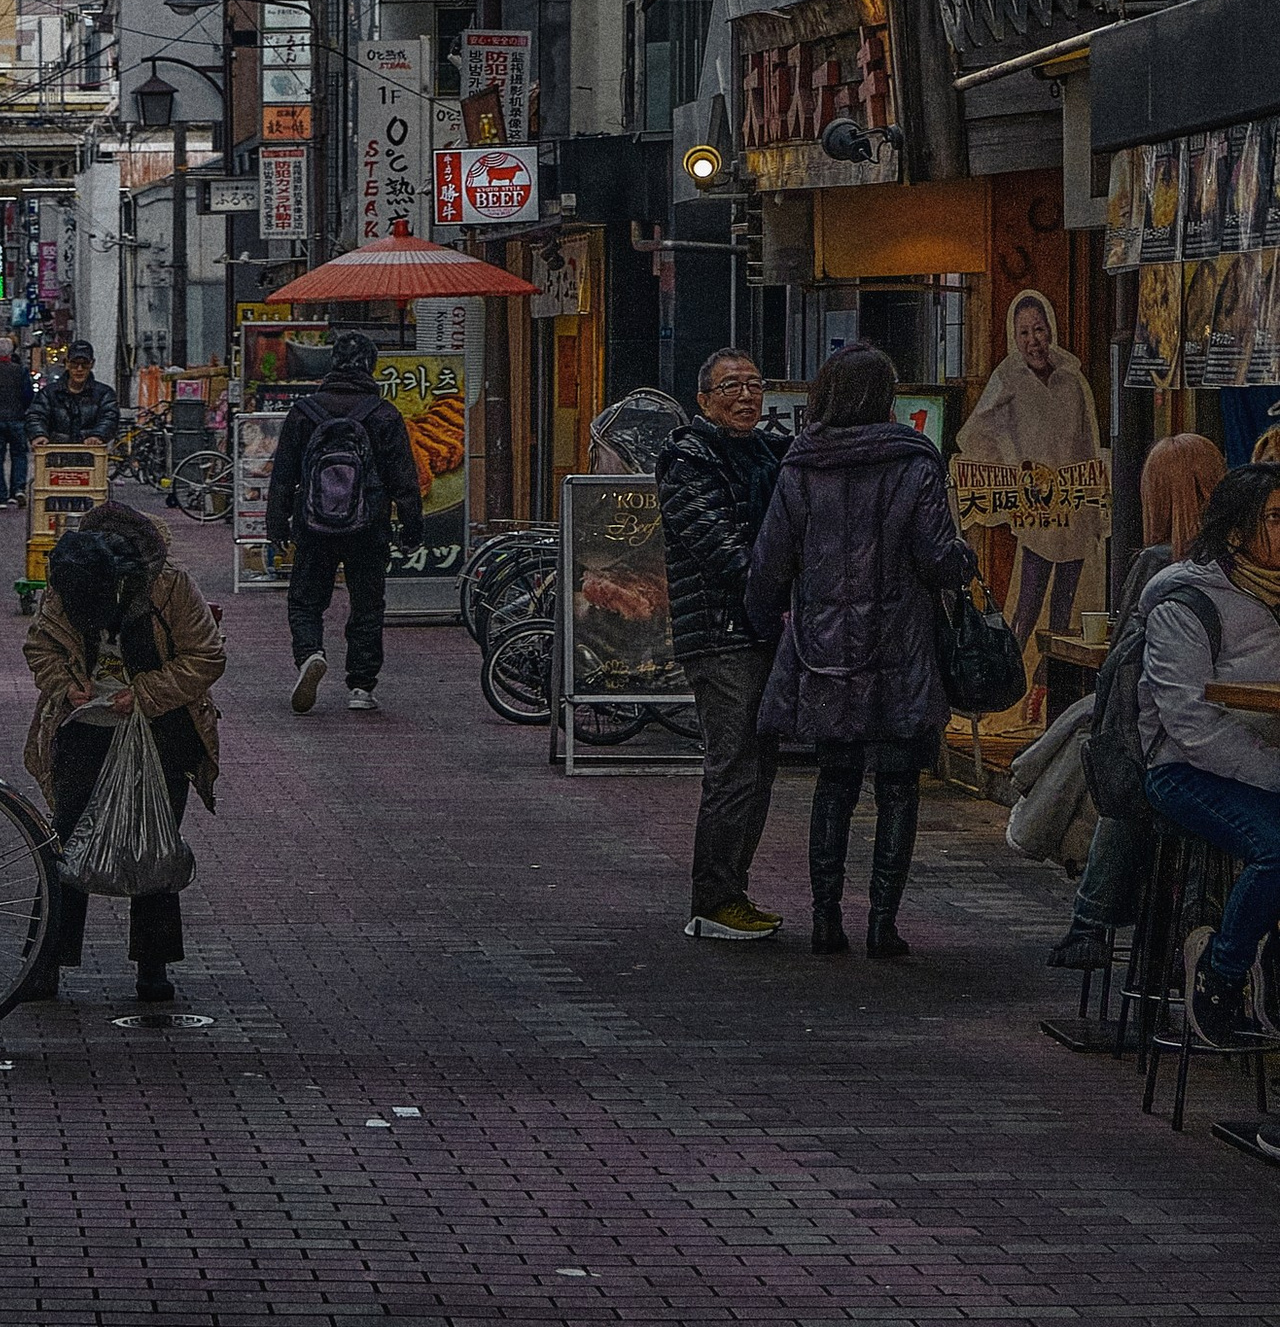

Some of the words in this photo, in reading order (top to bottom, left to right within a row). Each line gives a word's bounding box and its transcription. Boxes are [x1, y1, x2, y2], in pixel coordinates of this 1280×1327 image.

[378, 86, 402, 104] 1F
[216, 192, 255, 205] ふるや
[275, 161, 291, 229] 防犯カメラ作動中
[364, 140, 380, 239] STEAK
[475, 191, 524, 207] BEEF
[378, 366, 459, 398] 규카츠
[957, 462, 1018, 488] WESTERN
[617, 493, 660, 509] KOB
[960, 491, 1020, 519] 大阪
